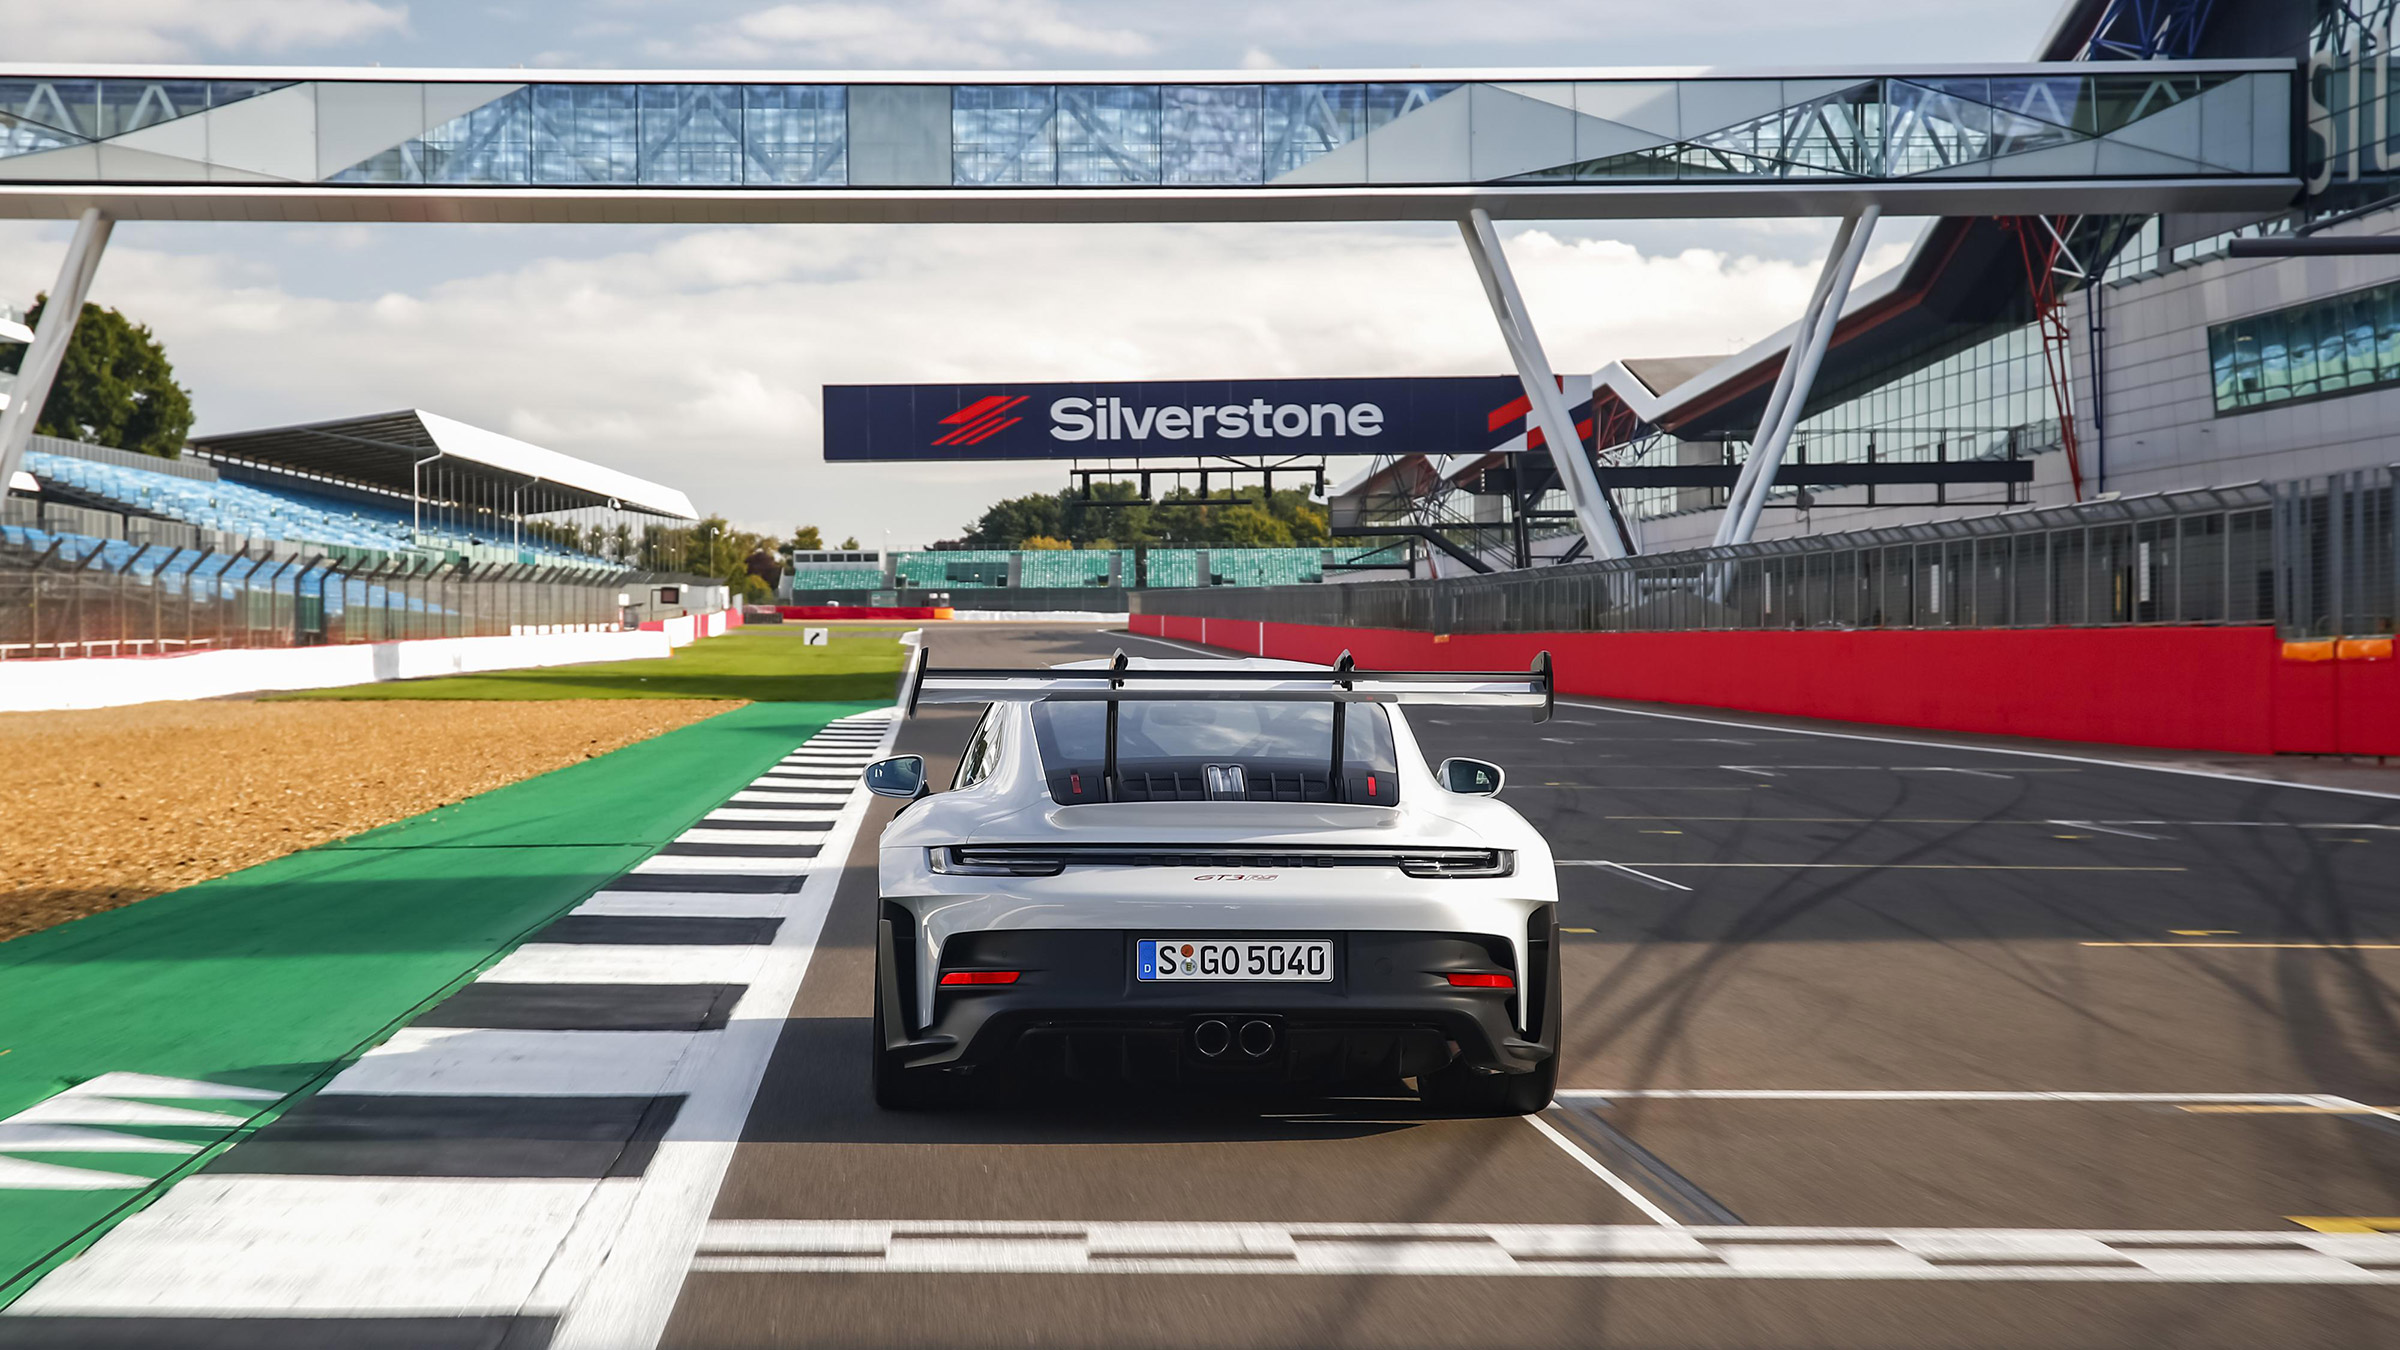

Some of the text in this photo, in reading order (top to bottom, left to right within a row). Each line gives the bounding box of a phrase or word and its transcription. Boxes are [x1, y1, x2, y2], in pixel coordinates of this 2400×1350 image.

[1050, 397, 1384, 441] Silverstone
[1134, 856, 1334, 867] PORSCHE
[1144, 945, 1325, 975] D S GO 5040
